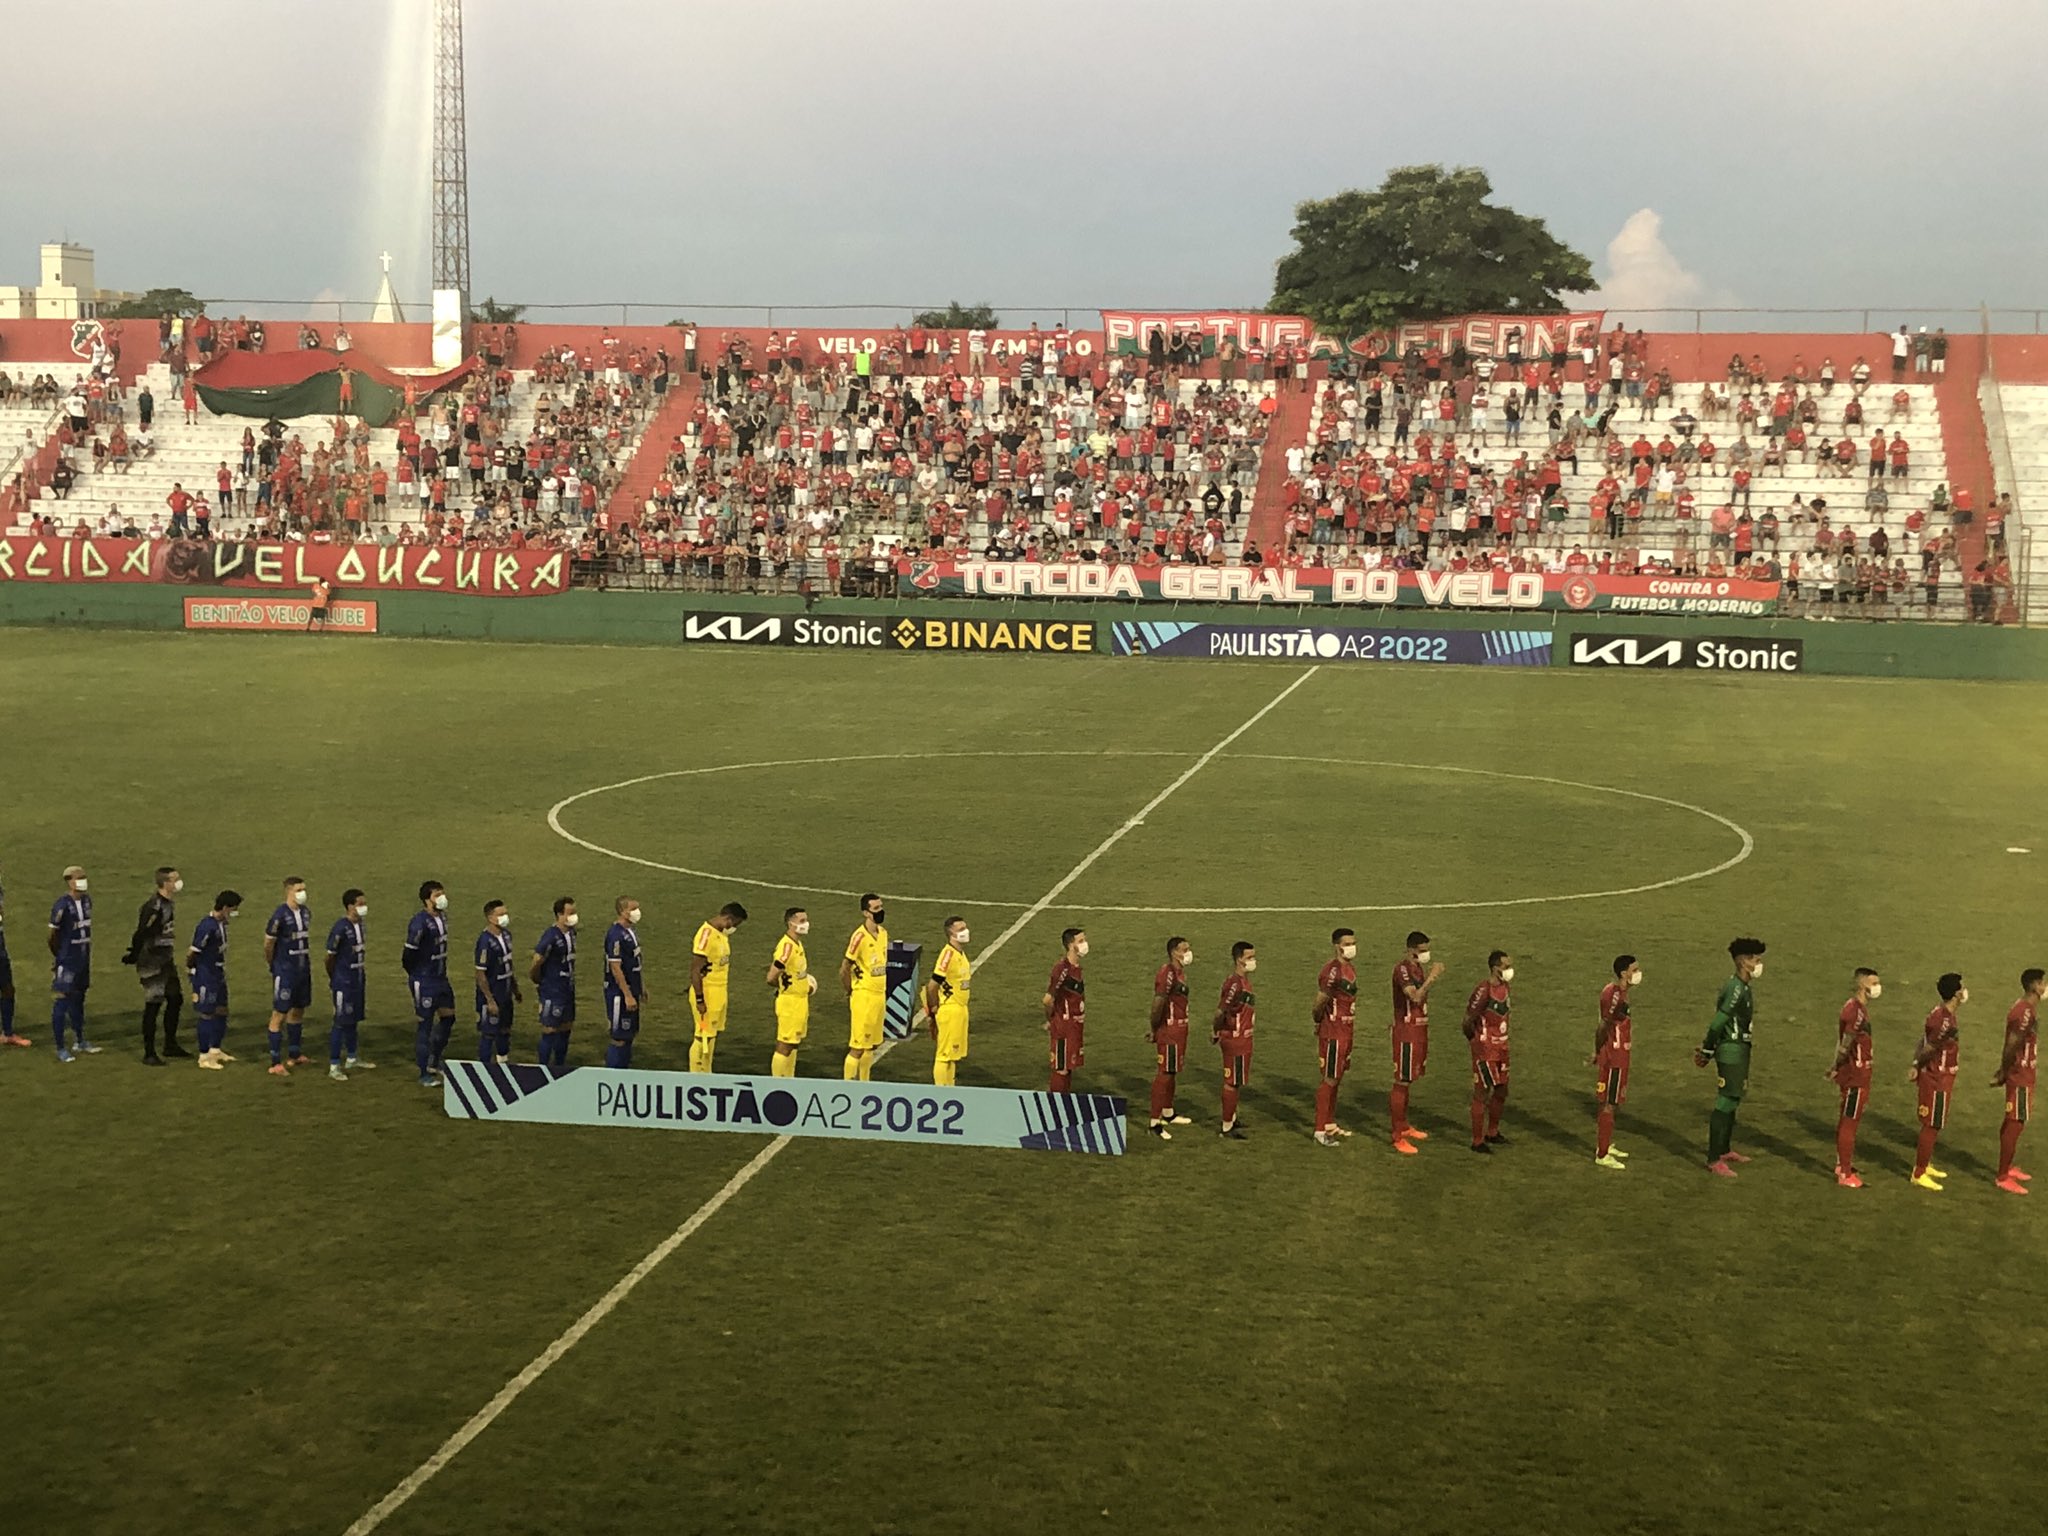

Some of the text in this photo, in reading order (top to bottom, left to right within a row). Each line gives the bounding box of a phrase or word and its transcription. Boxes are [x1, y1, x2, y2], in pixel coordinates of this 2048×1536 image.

[818, 337, 877, 354] VELO
[954, 562, 1144, 597] TORCIDA
[1160, 566, 1314, 602] GERAL
[1333, 568, 1398, 602] DO
[1415, 570, 1544, 607] VELO
[1649, 580, 1730, 595] CONTRA O
[191, 600, 366, 627] BENITÃO VELO LUBE
[1610, 596, 1763, 615] FUTEBOL MODERNO
[794, 618, 882, 645] Stonic
[925, 620, 1093, 651] BINANCE
[1210, 628, 1448, 661] PAULISTÃO A2 2022
[1696, 641, 1797, 671] Stonic
[598, 1081, 965, 1136] PAULISTÃO A2 2022
